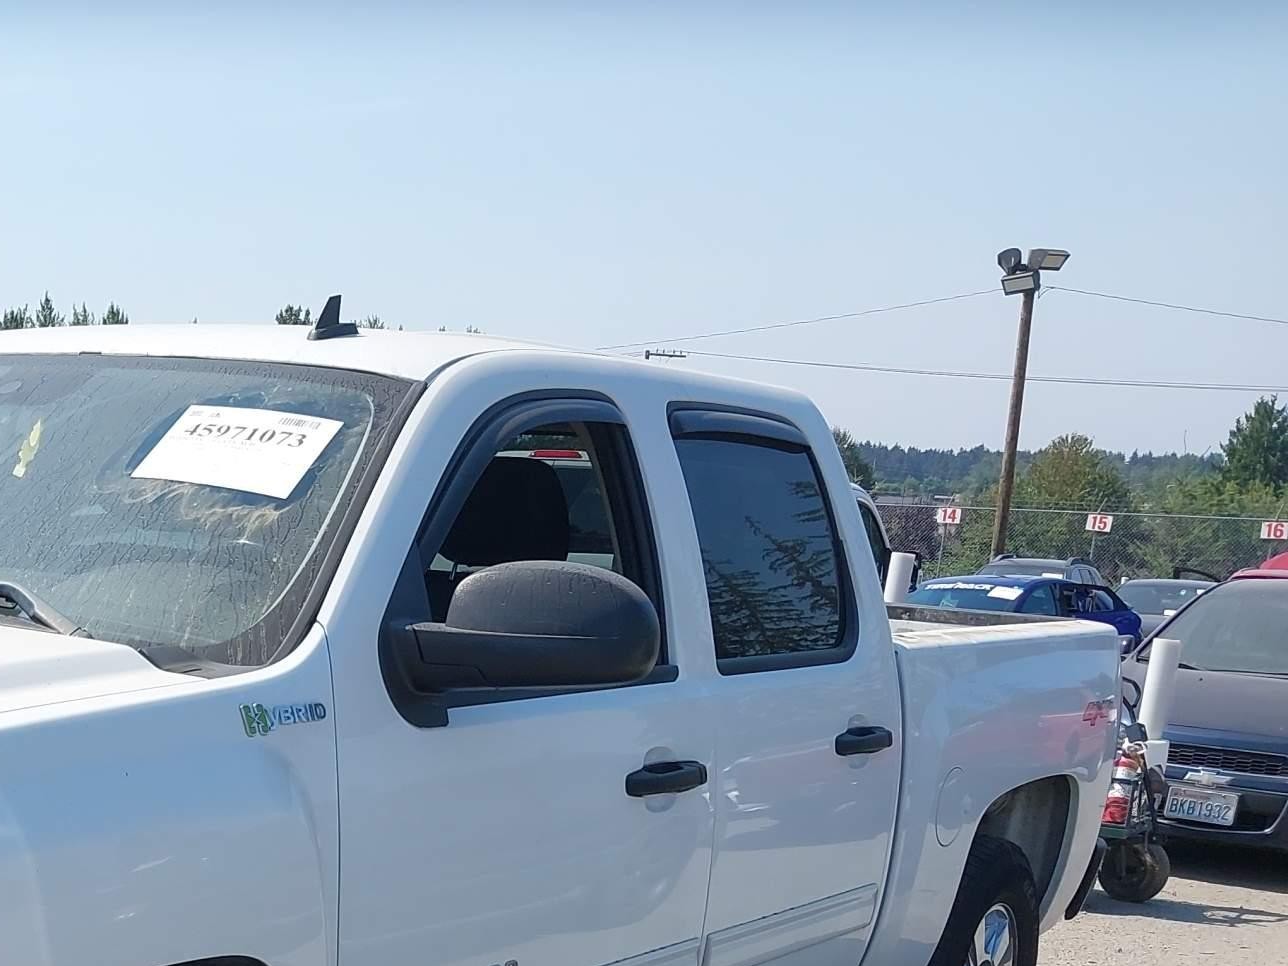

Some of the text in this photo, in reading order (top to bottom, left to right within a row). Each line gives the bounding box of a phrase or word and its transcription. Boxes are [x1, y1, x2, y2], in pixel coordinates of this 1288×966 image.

[184, 423, 307, 448] 45971073
[942, 509, 957, 522] 14
[1092, 516, 1109, 530] 15
[1267, 523, 1285, 537] 16
[1169, 797, 1231, 821] BKB1932
